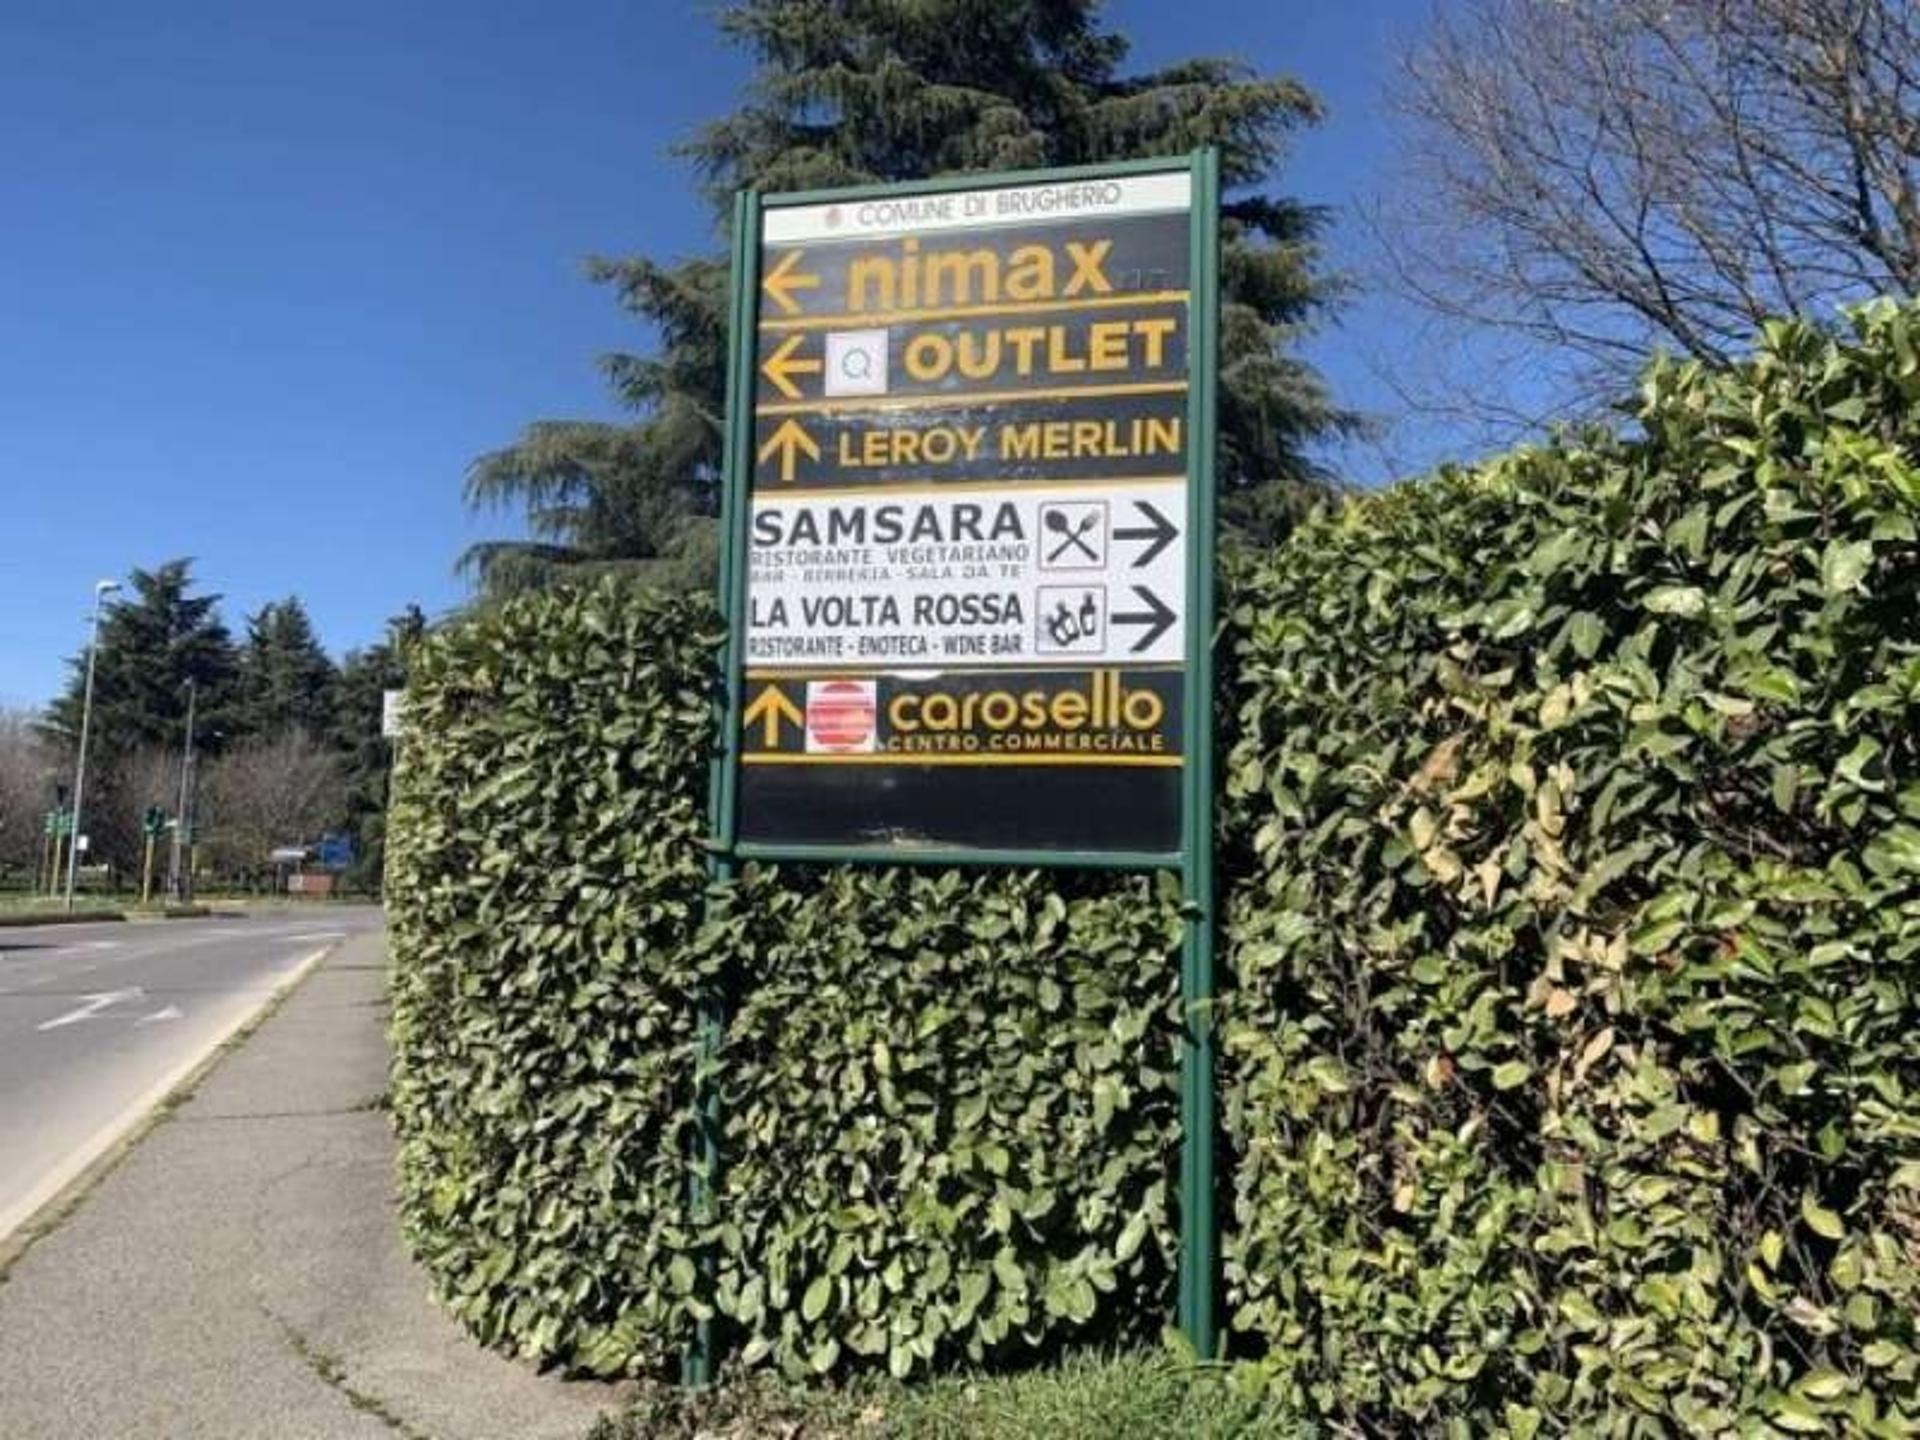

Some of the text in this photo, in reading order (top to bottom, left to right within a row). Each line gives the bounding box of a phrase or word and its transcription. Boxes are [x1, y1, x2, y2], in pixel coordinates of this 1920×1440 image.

[858, 182, 1122, 225] COMUNE DI BRUGHERIO
[848, 237, 1114, 312] nimax
[905, 319, 1176, 380] OUTLET
[838, 416, 1180, 468] LEROY MERLIN
[754, 503, 1024, 546] SAMSARA
[750, 543, 1030, 566] RISTORANTE VEGETARIANO
[905, 566, 956, 581] SALA
[751, 593, 1023, 627] LA VOLTA ROSSA
[749, 636, 843, 657] RISTORANTE
[858, 635, 928, 657] ENOTECA
[944, 635, 987, 655] WINE
[991, 634, 1022, 654] BAR
[889, 671, 1163, 730] carosello
[888, 732, 1165, 751] CENTRO COMMERCIALE
